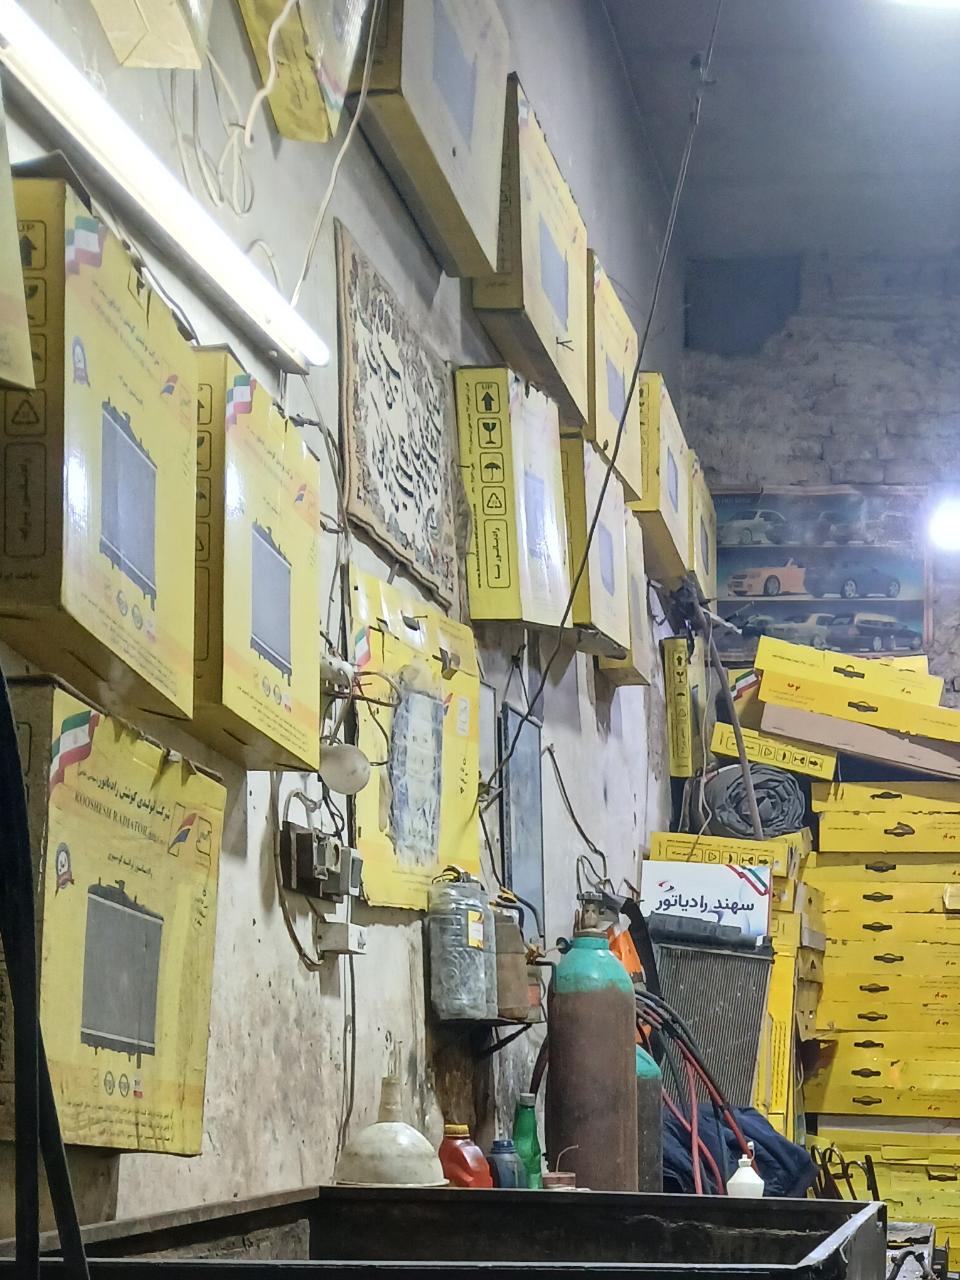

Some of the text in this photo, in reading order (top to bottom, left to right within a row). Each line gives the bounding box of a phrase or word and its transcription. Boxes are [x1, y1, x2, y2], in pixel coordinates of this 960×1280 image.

[74, 791, 148, 834] KOOSHESH RADIATOR
[655, 894, 755, 914] سهند رادیاتور
